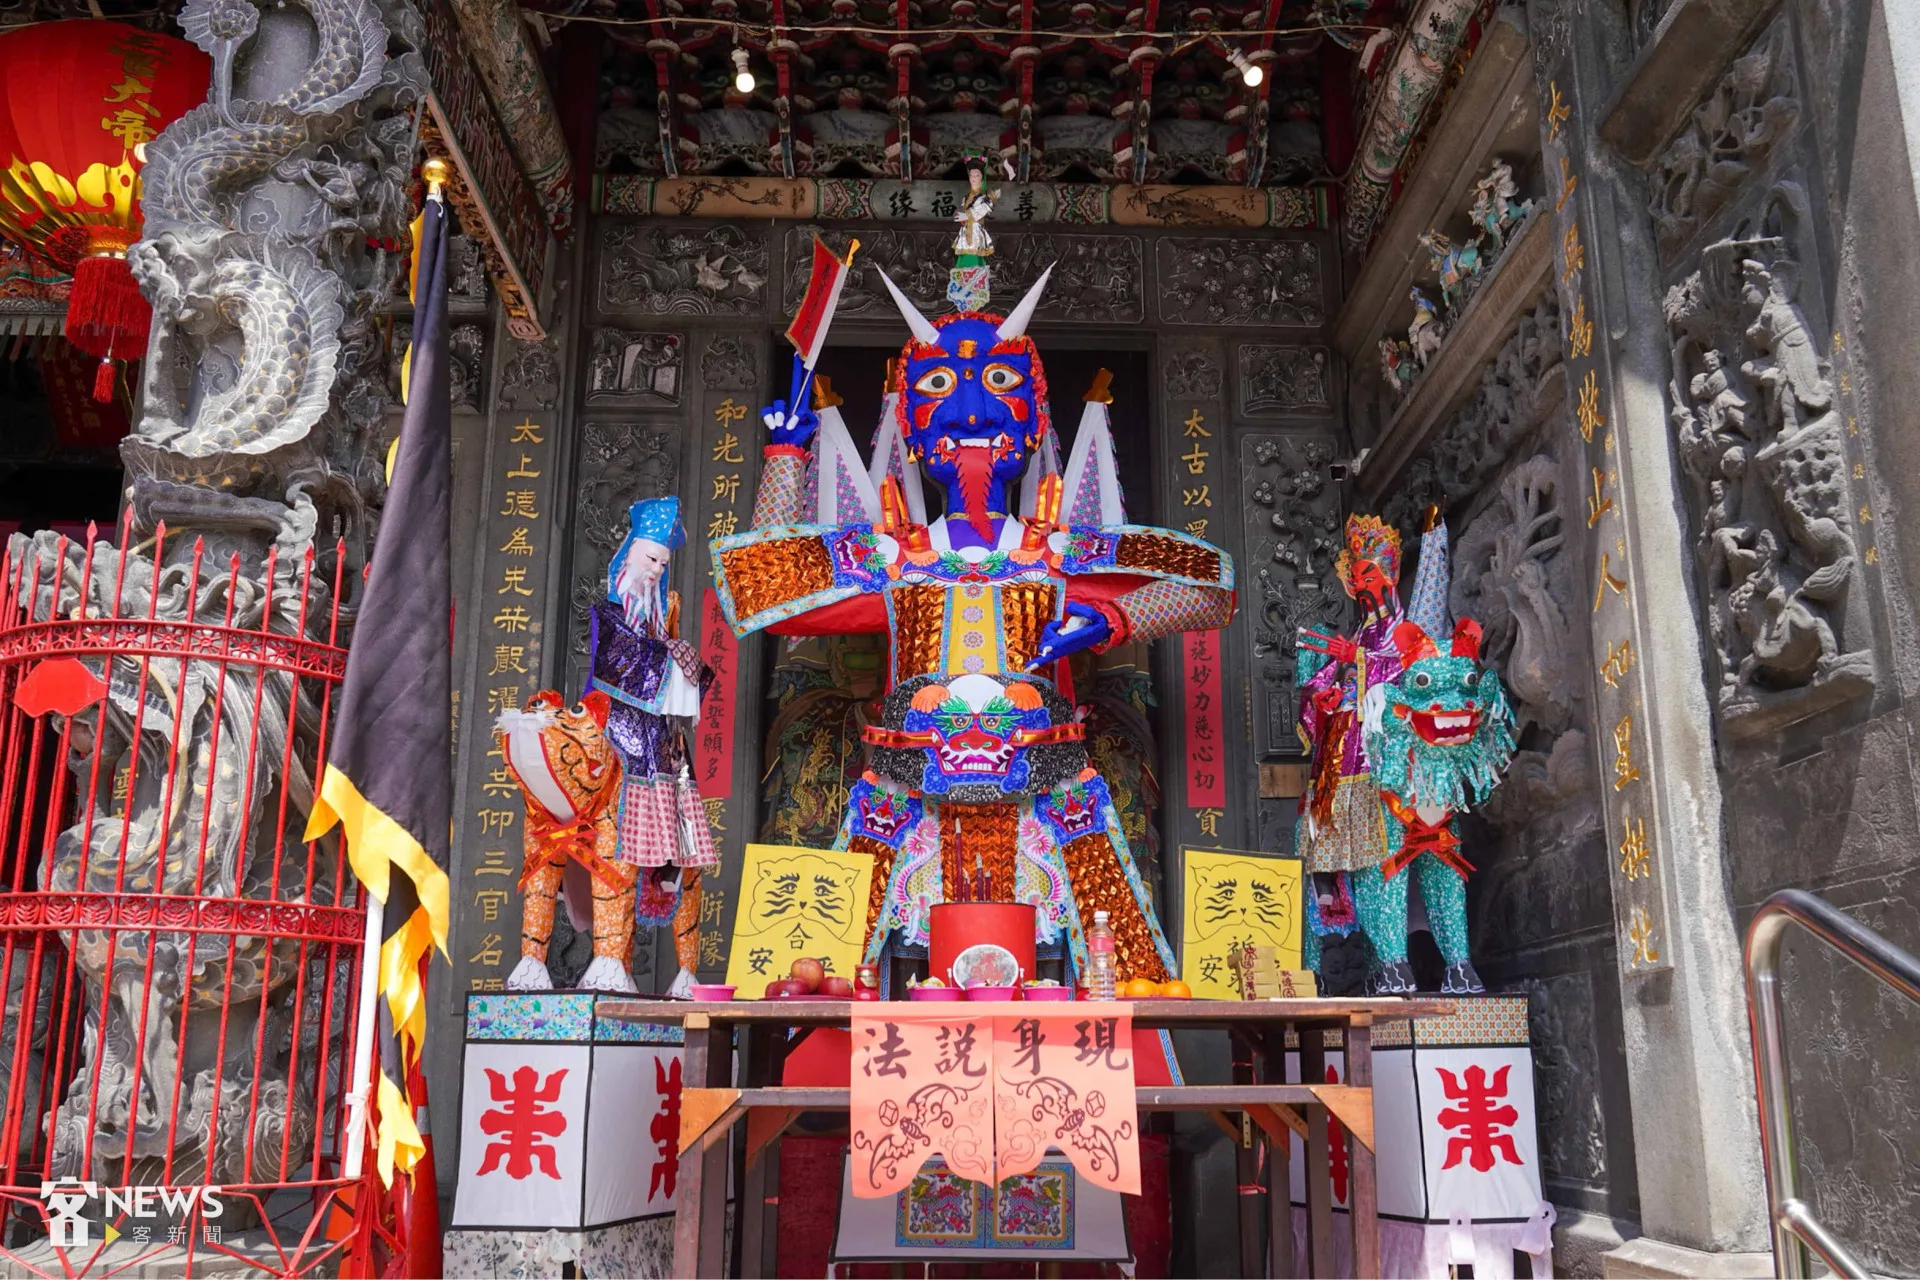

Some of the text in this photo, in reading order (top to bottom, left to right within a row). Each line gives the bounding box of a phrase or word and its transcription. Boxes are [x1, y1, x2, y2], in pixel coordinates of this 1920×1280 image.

[888, 189, 1038, 222] 善福緣
[785, 922, 813, 950] 合
[747, 947, 774, 976] 安
[1200, 954, 1222, 983] 安
